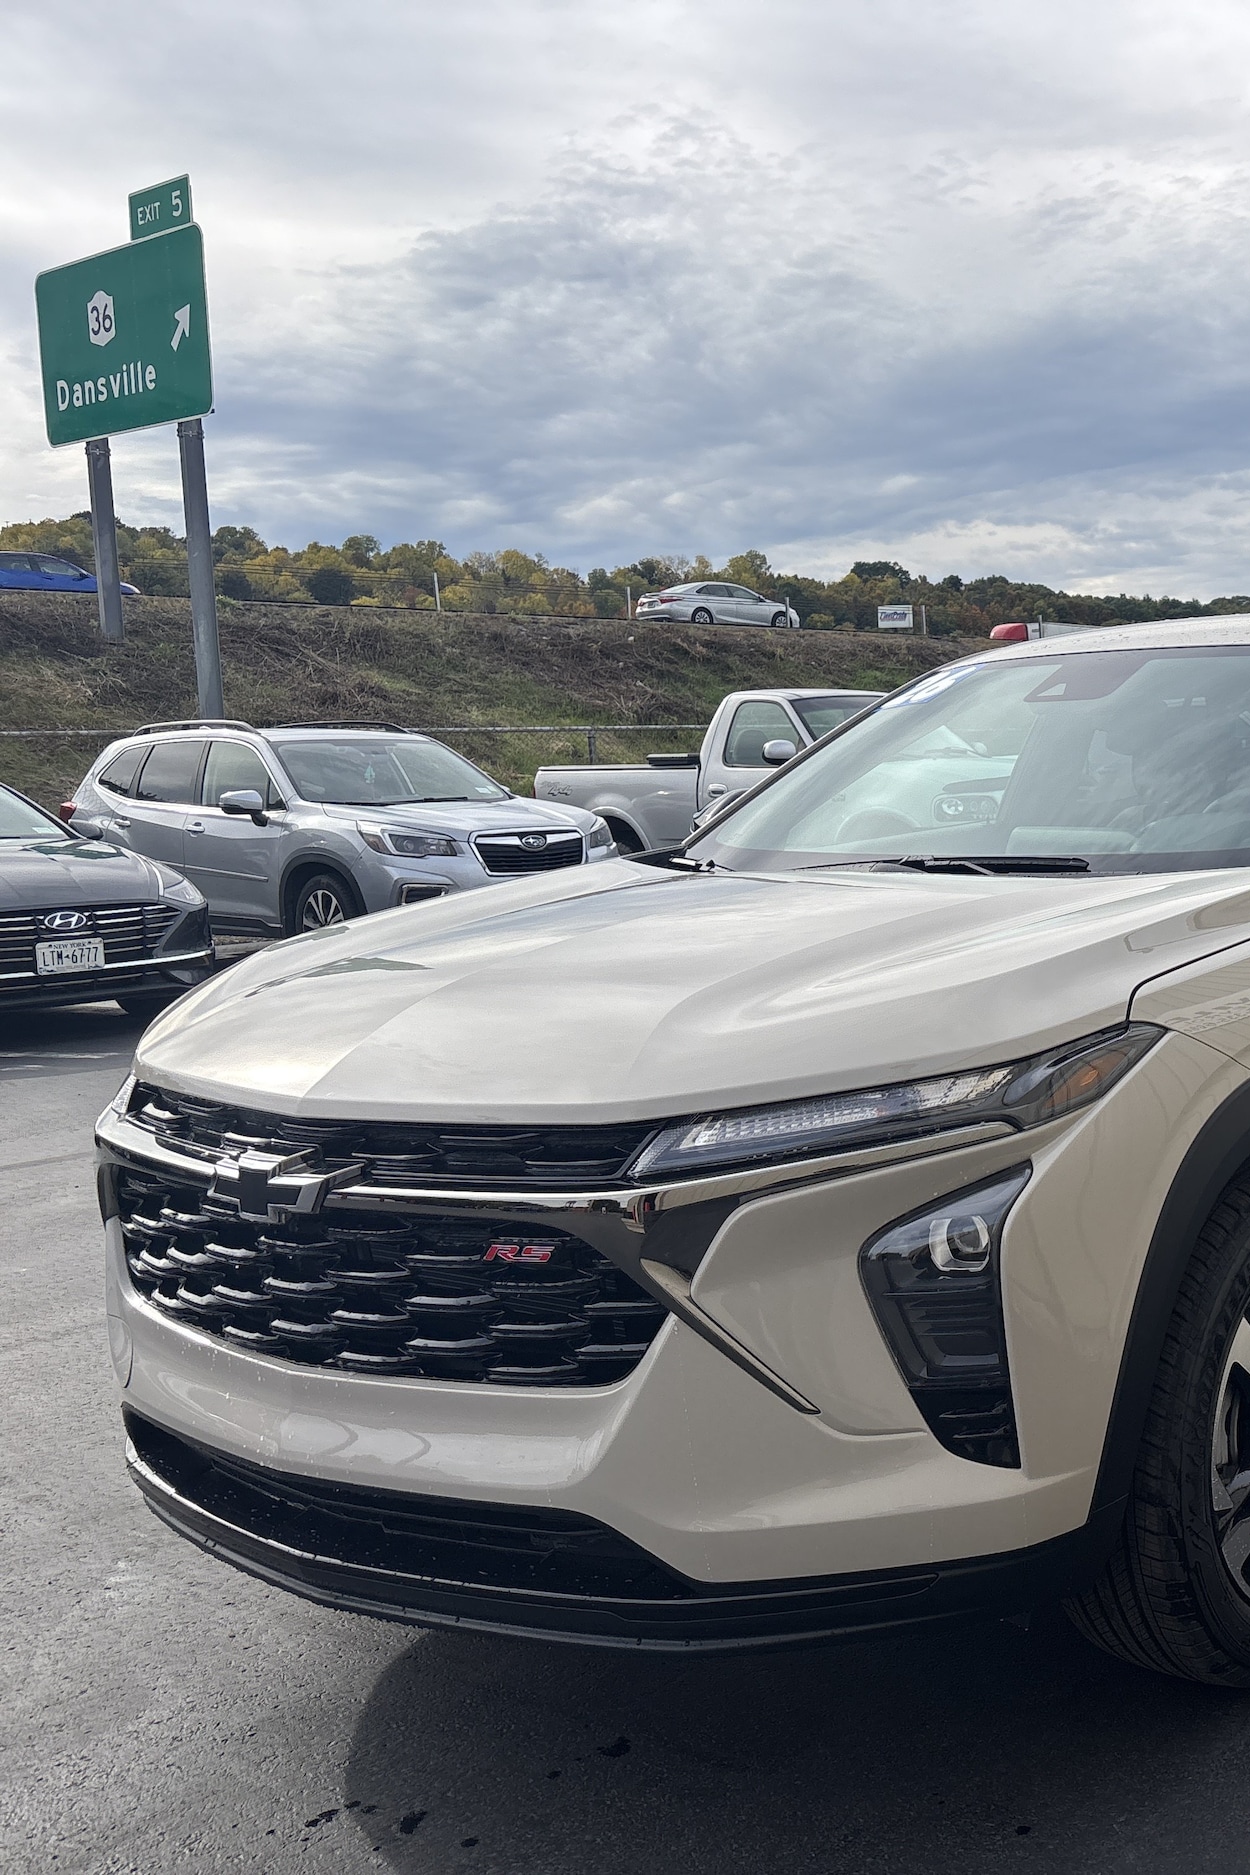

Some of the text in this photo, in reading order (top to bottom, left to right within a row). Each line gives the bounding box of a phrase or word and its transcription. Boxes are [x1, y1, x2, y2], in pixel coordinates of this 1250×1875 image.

[137, 190, 183, 225] EXIT 5
[90, 302, 113, 336] 36
[56, 360, 157, 411] Dansville
[483, 1244, 555, 1262] RS
